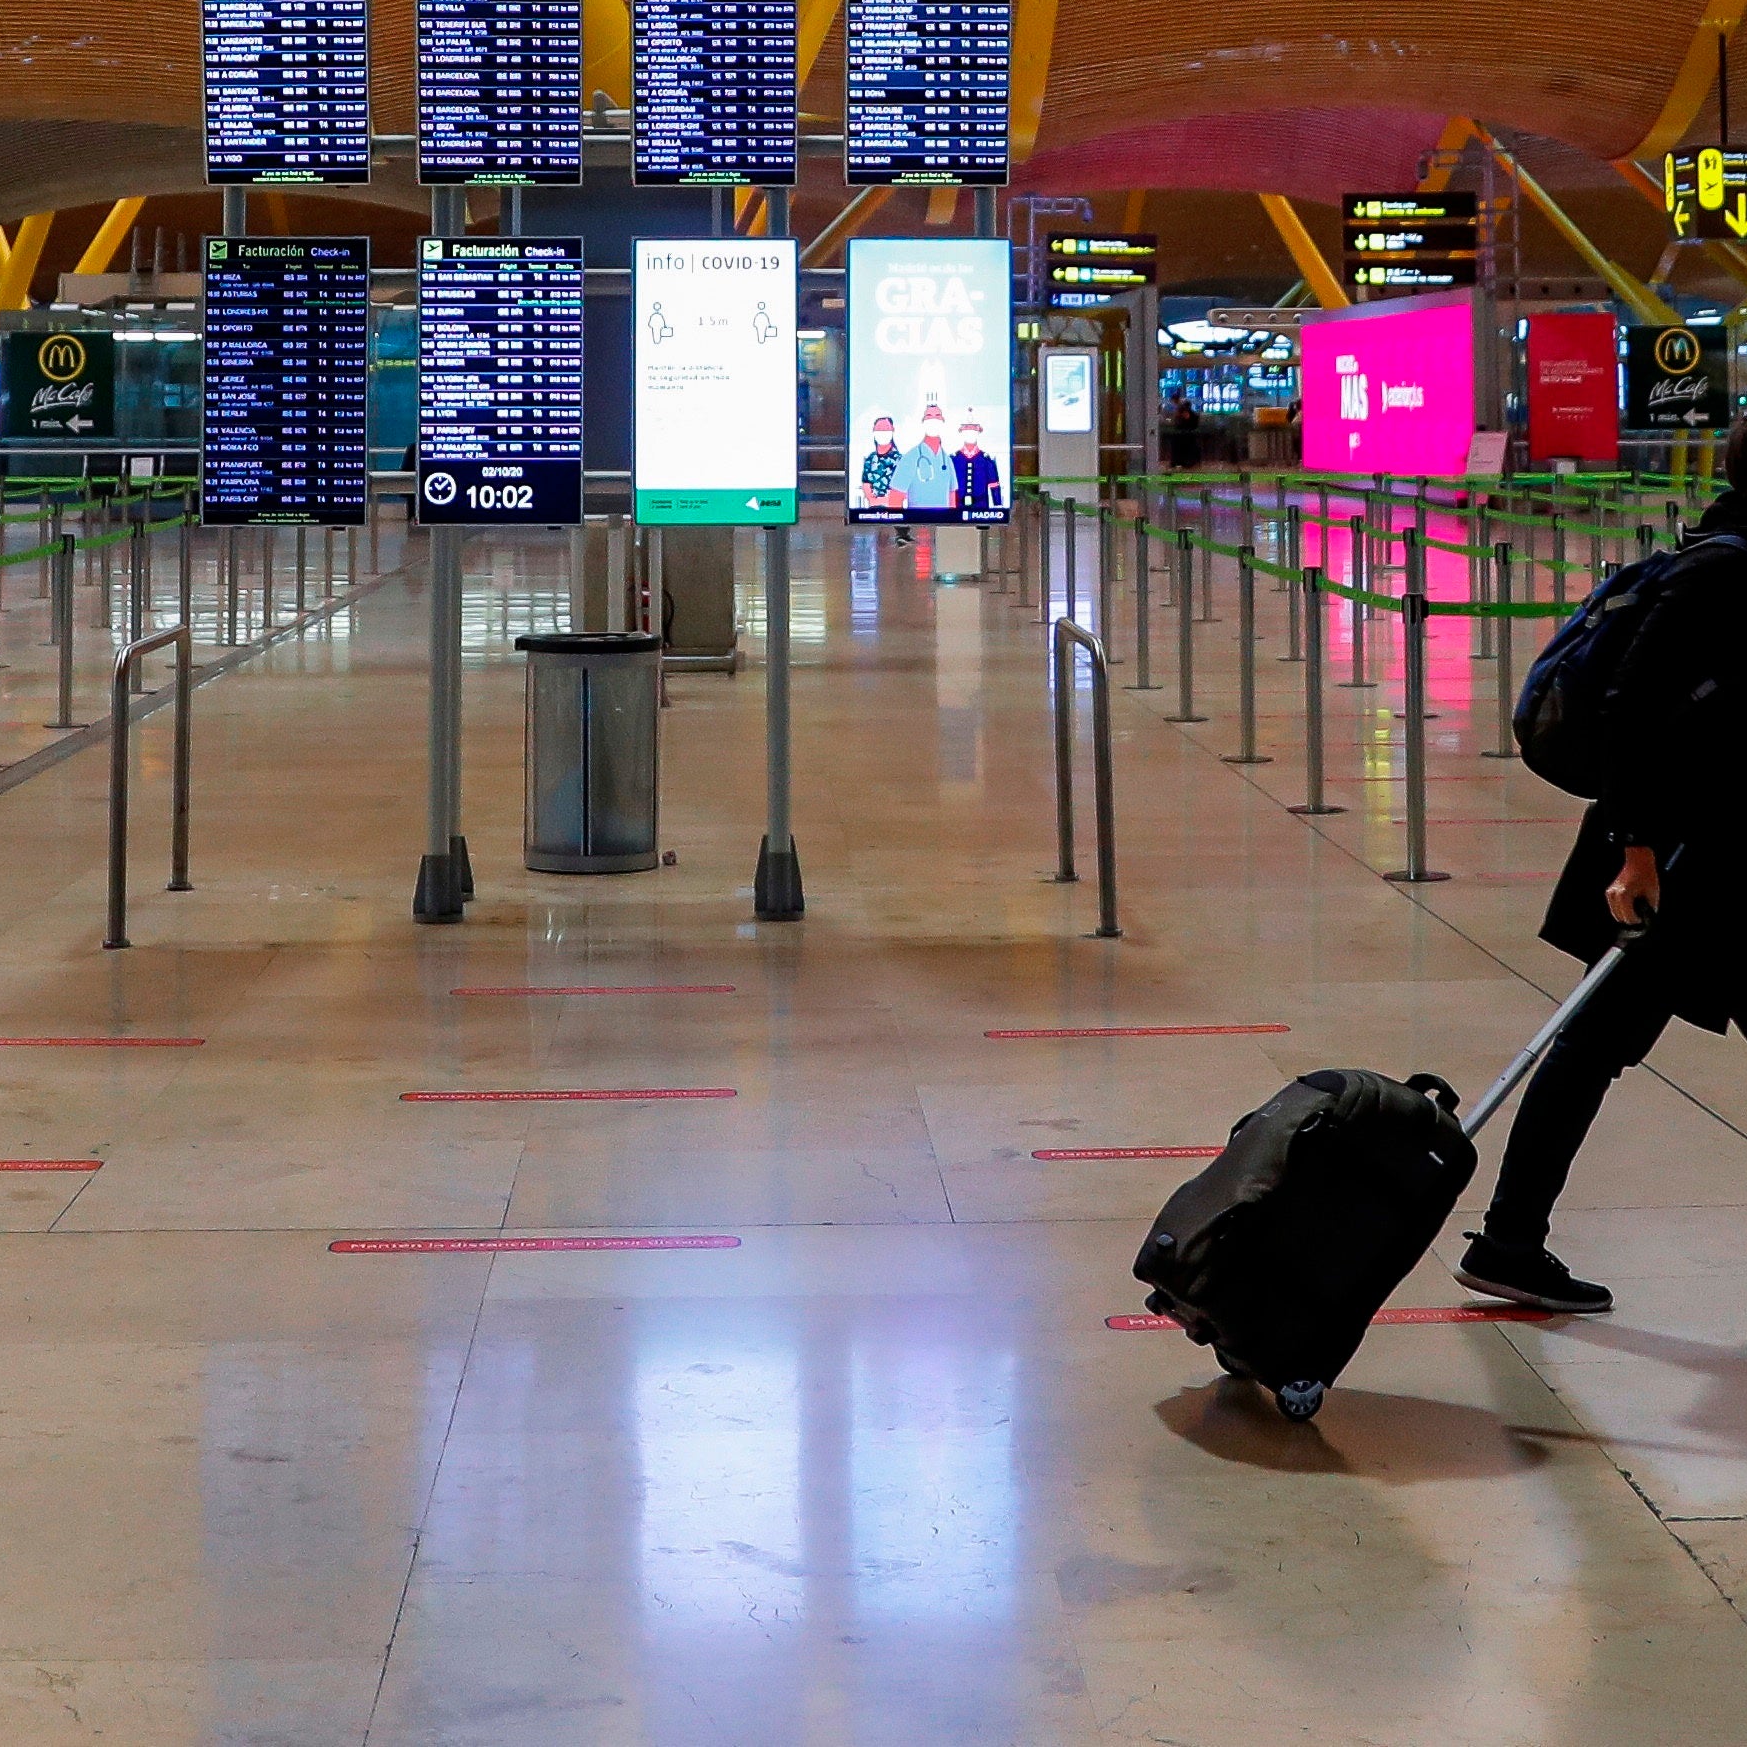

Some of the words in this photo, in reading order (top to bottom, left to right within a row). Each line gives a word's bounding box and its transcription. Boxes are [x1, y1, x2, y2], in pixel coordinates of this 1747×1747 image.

[239, 245, 303, 256] Facturación
[311, 248, 349, 256] Check-in
[453, 245, 519, 256] Facturación
[525, 247, 564, 257] Check-in
[647, 253, 685, 270] info
[702, 256, 780, 270] COVID-19
[875, 316, 984, 353] CIAS
[467, 486, 532, 508] 10:02
[971, 511, 1005, 520] MADRID
